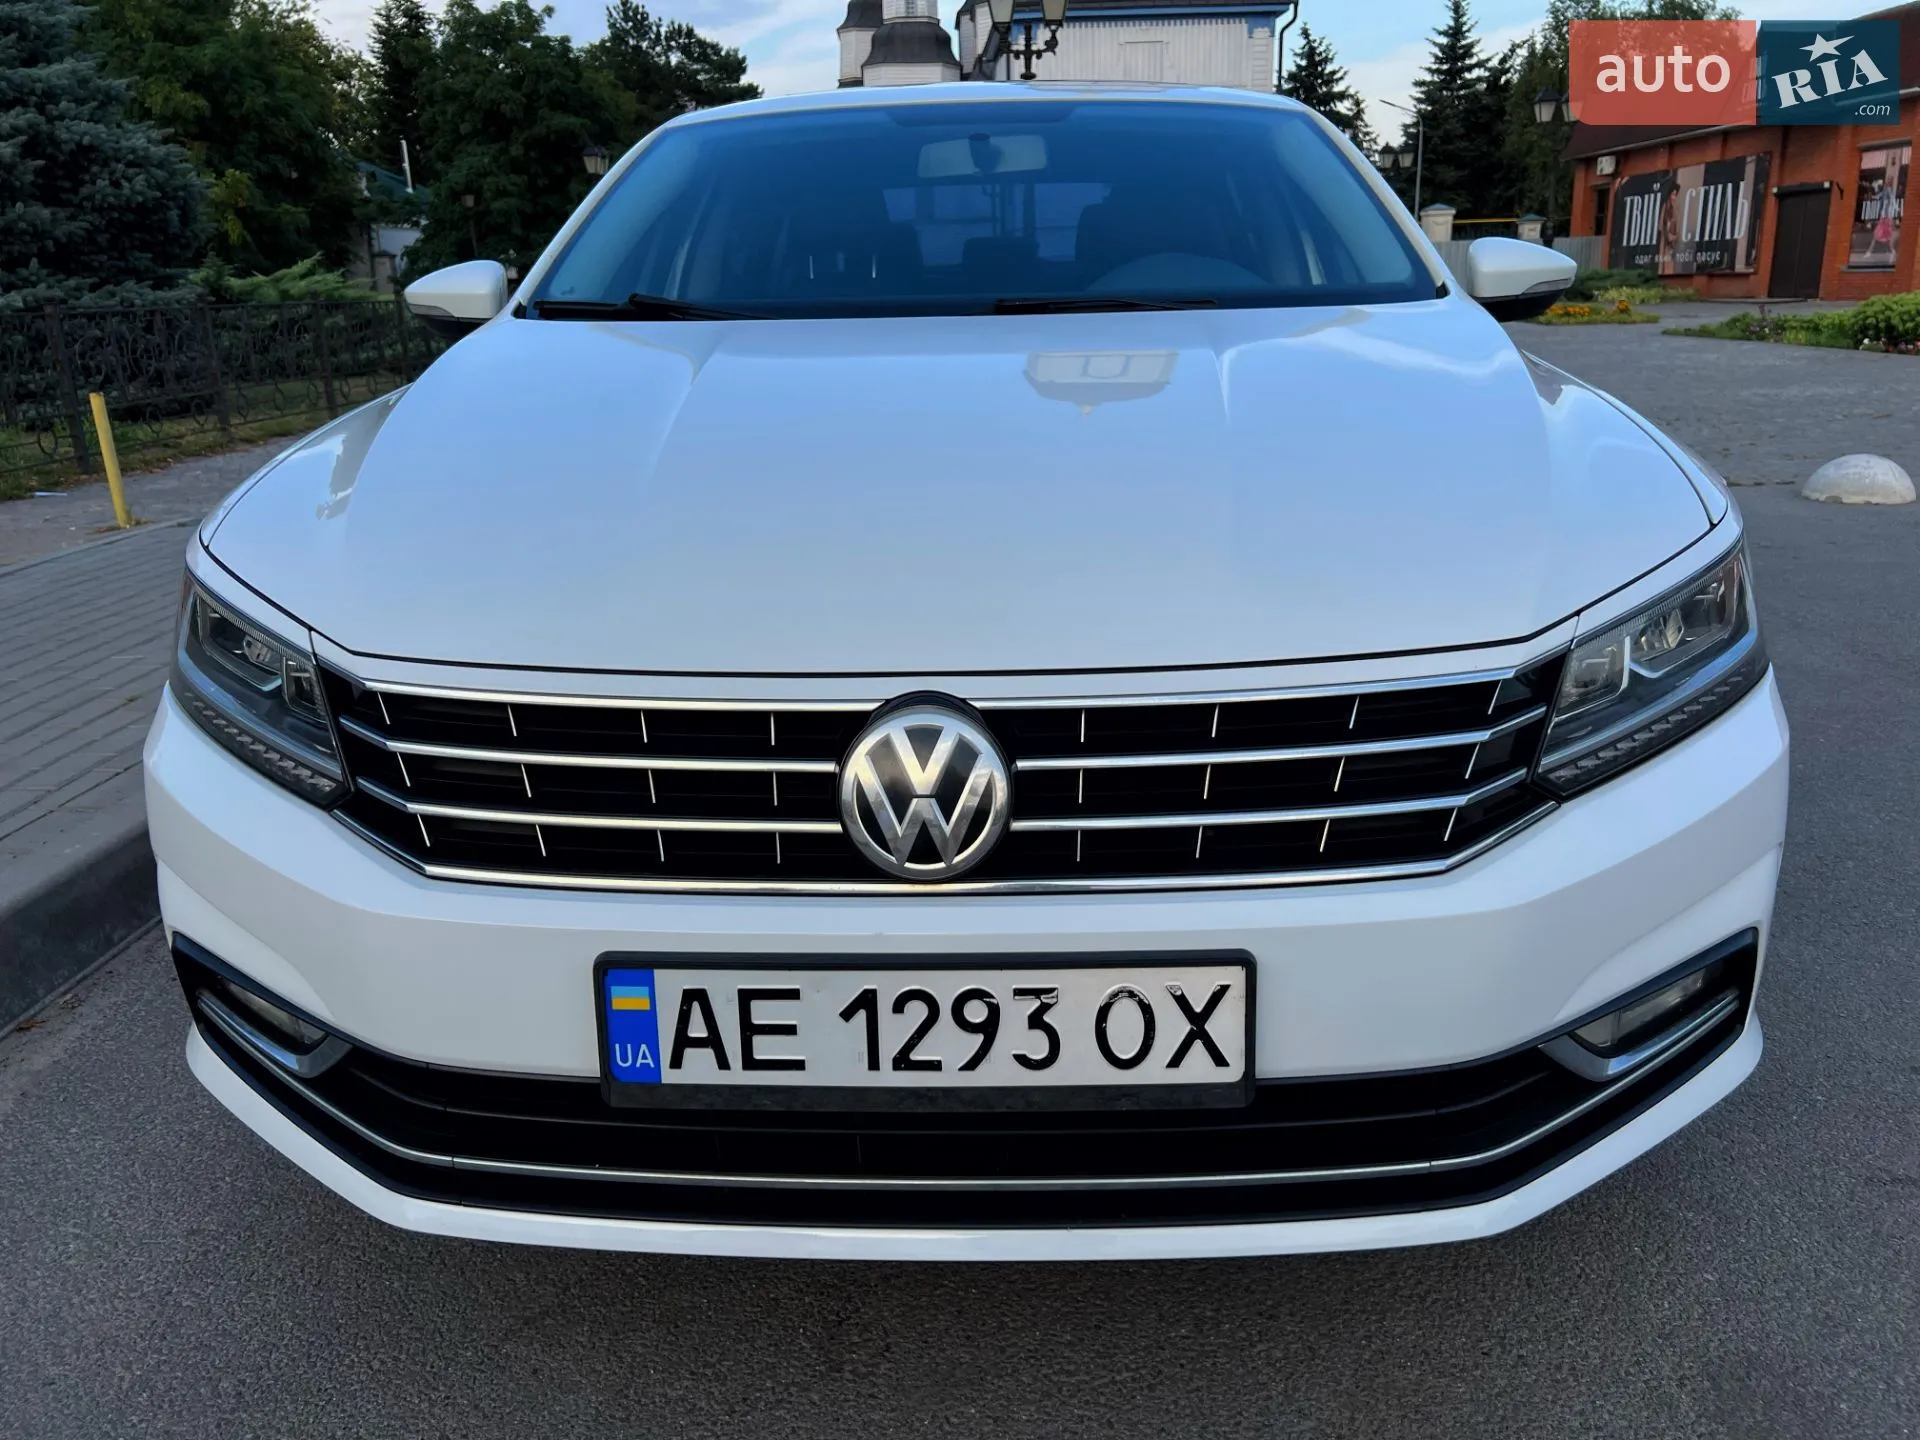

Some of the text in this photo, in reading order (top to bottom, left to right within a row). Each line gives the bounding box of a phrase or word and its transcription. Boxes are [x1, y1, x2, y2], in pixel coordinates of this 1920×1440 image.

[1681, 180, 1749, 242] СТИЛЬ
[614, 1042, 655, 1068] UA
[668, 983, 1232, 1073] AE 1293 OX
